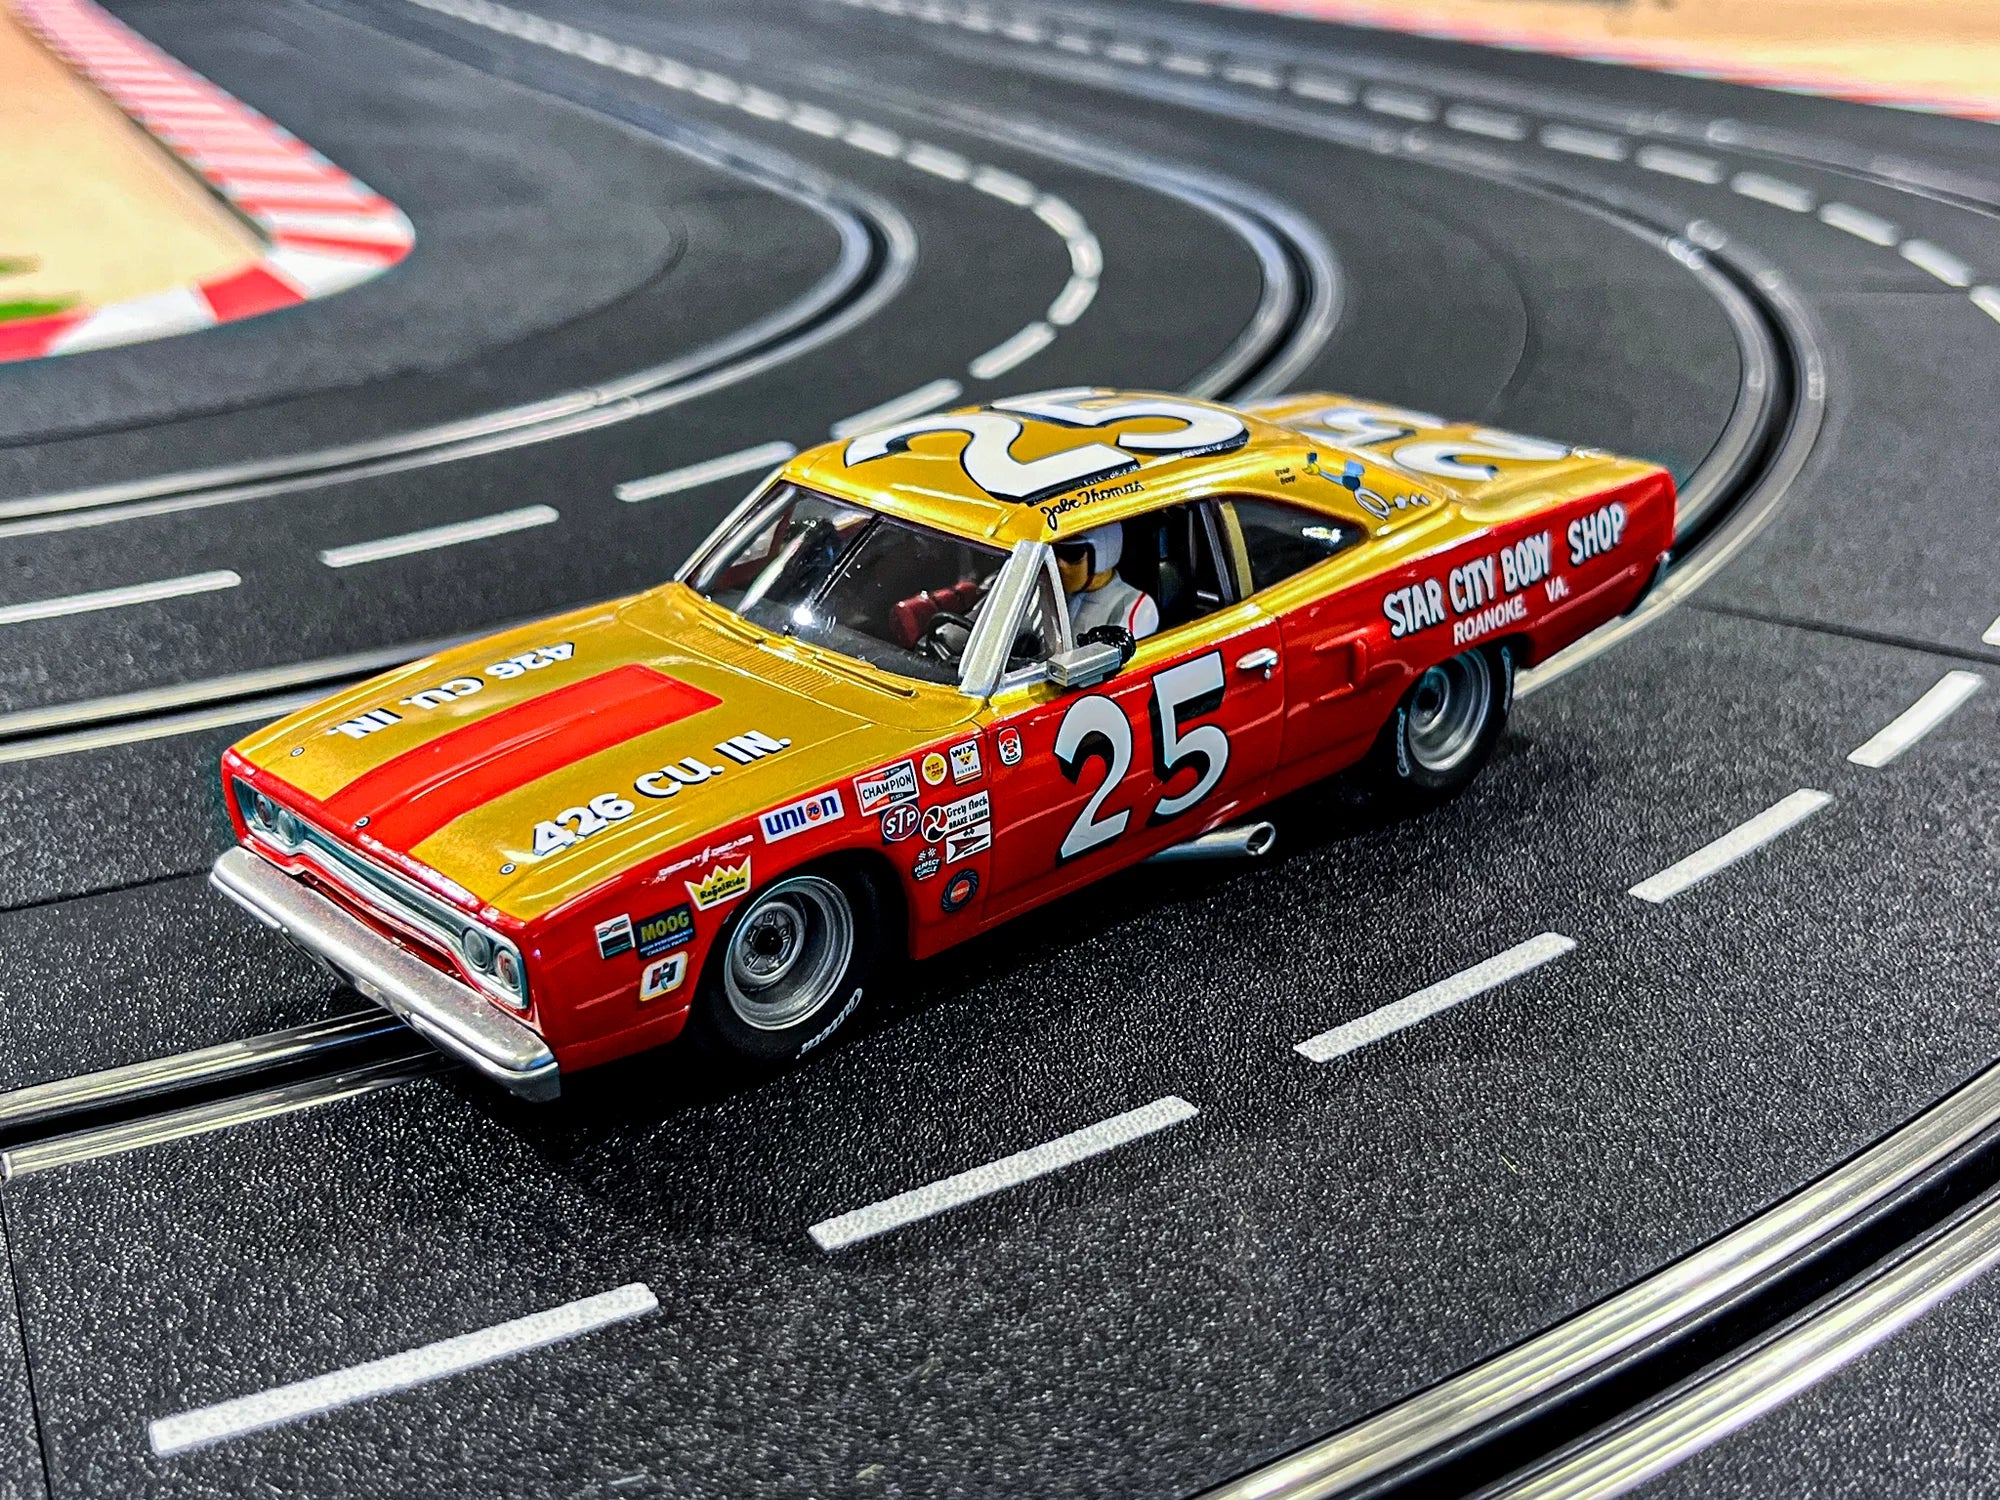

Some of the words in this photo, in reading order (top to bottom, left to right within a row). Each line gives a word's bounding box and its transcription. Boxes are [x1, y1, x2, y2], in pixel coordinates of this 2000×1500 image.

[844, 386, 1250, 504] 25
[1039, 498, 1081, 532] Jabe
[1077, 480, 1145, 506] Thomas
[1383, 577, 1446, 638] STAR
[1449, 555, 1495, 615] CITY
[1500, 530, 1551, 593] BODY
[1567, 501, 1627, 567] SHOP
[1544, 575, 1569, 602] VA.
[484, 641, 575, 680] 426
[398, 676, 485, 710] CU.
[326, 707, 403, 740] IN.
[950, 743, 977, 758] WIX
[1053, 650, 1231, 869] 25
[532, 792, 636, 856] 426
[634, 756, 726, 799] CU.
[713, 729, 792, 766] IN.
[862, 773, 912, 800] CHAMPION
[886, 806, 917, 835] STP
[948, 815, 968, 830] BRAKE
[914, 858, 940, 873] PERFECT
[916, 865, 938, 878] CIRCLE
[640, 910, 690, 944] MOOG
